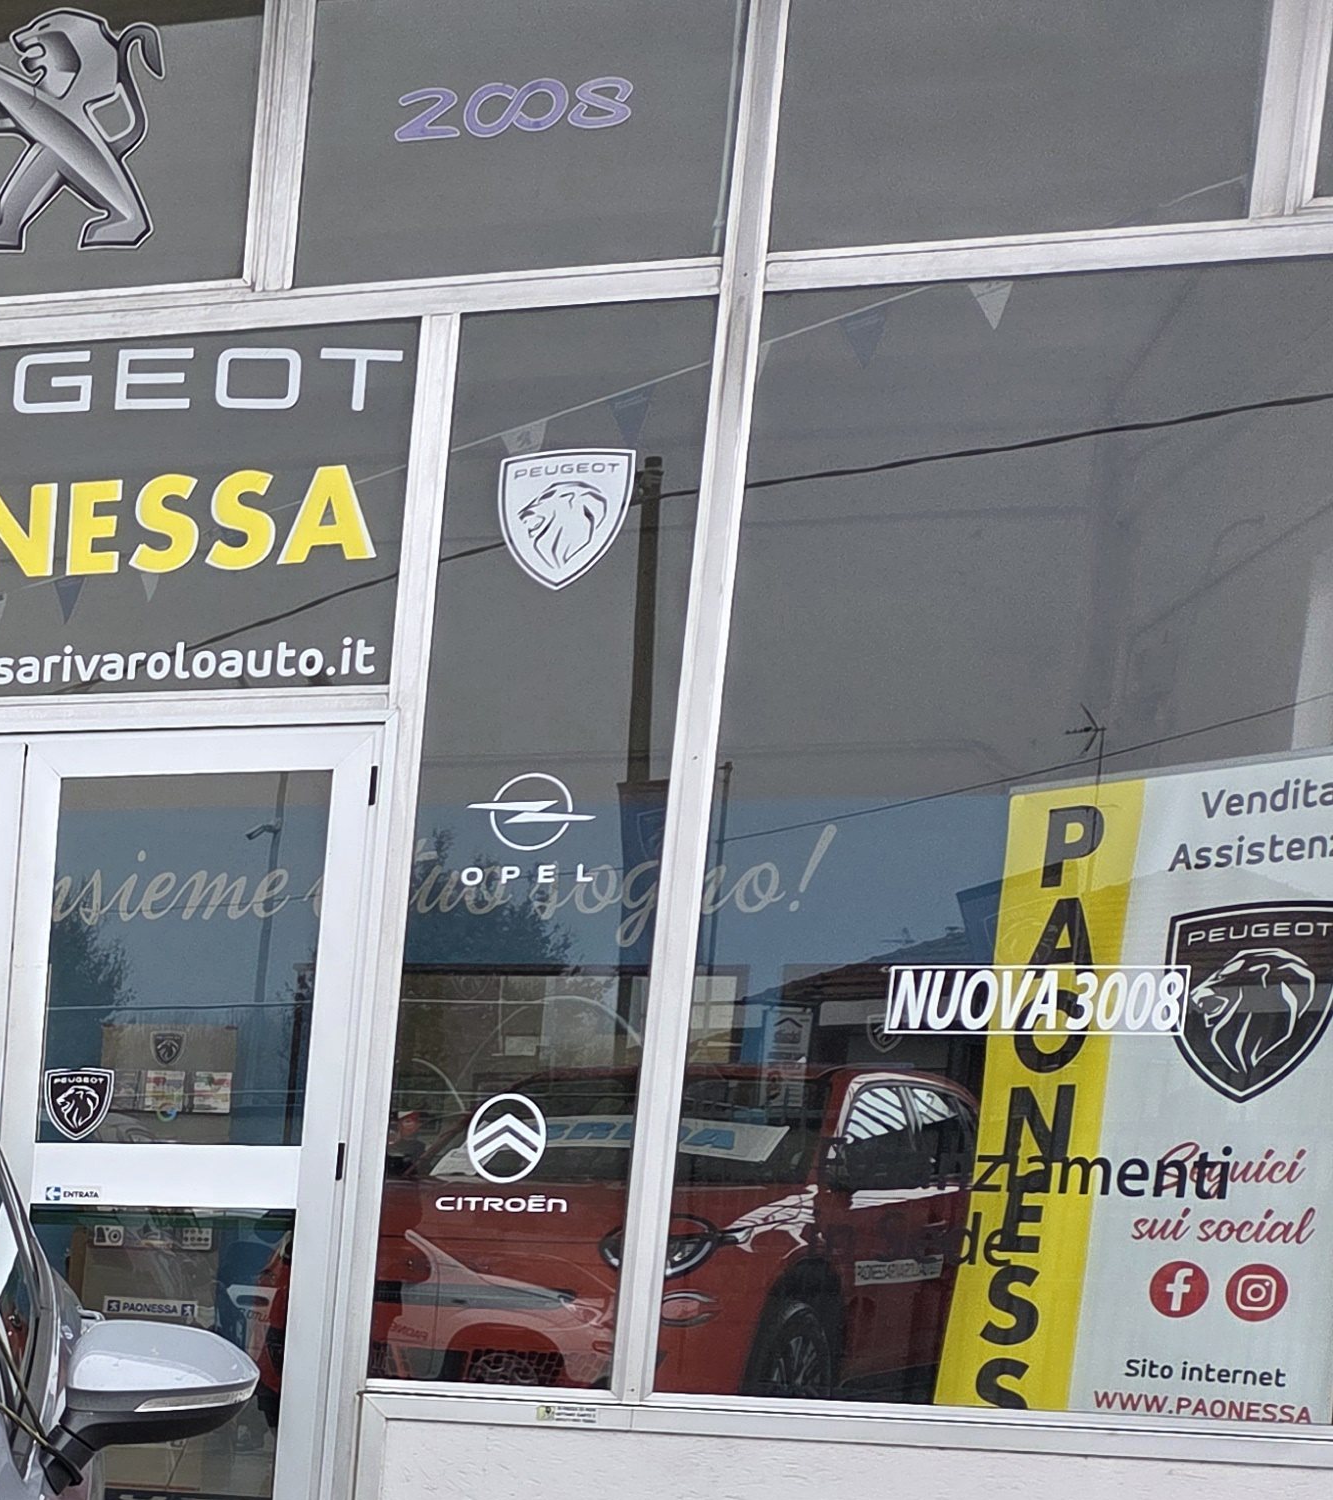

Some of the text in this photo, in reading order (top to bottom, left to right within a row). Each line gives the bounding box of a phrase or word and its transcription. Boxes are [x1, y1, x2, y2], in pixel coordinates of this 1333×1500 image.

[394, 75, 633, 142] 2008
[514, 462, 621, 480] PEUGEOT
[1201, 778, 1333, 820] Vendita
[1167, 834, 1333, 873] Assisten
[52, 850, 291, 926] nsieme
[460, 864, 594, 887] OPEL
[1187, 922, 1333, 947] PEUGEOT
[889, 970, 1185, 1031] NUOVA 3008
[52, 1076, 105, 1085] PEUGEOT
[63, 1190, 100, 1199] ENTRATA
[1131, 1207, 1317, 1245] sui social
[122, 1302, 178, 1315] PAONESSA
[1124, 1358, 1287, 1388] Sito internet
[1093, 1391, 1313, 1425] WWW.PAONESSA
